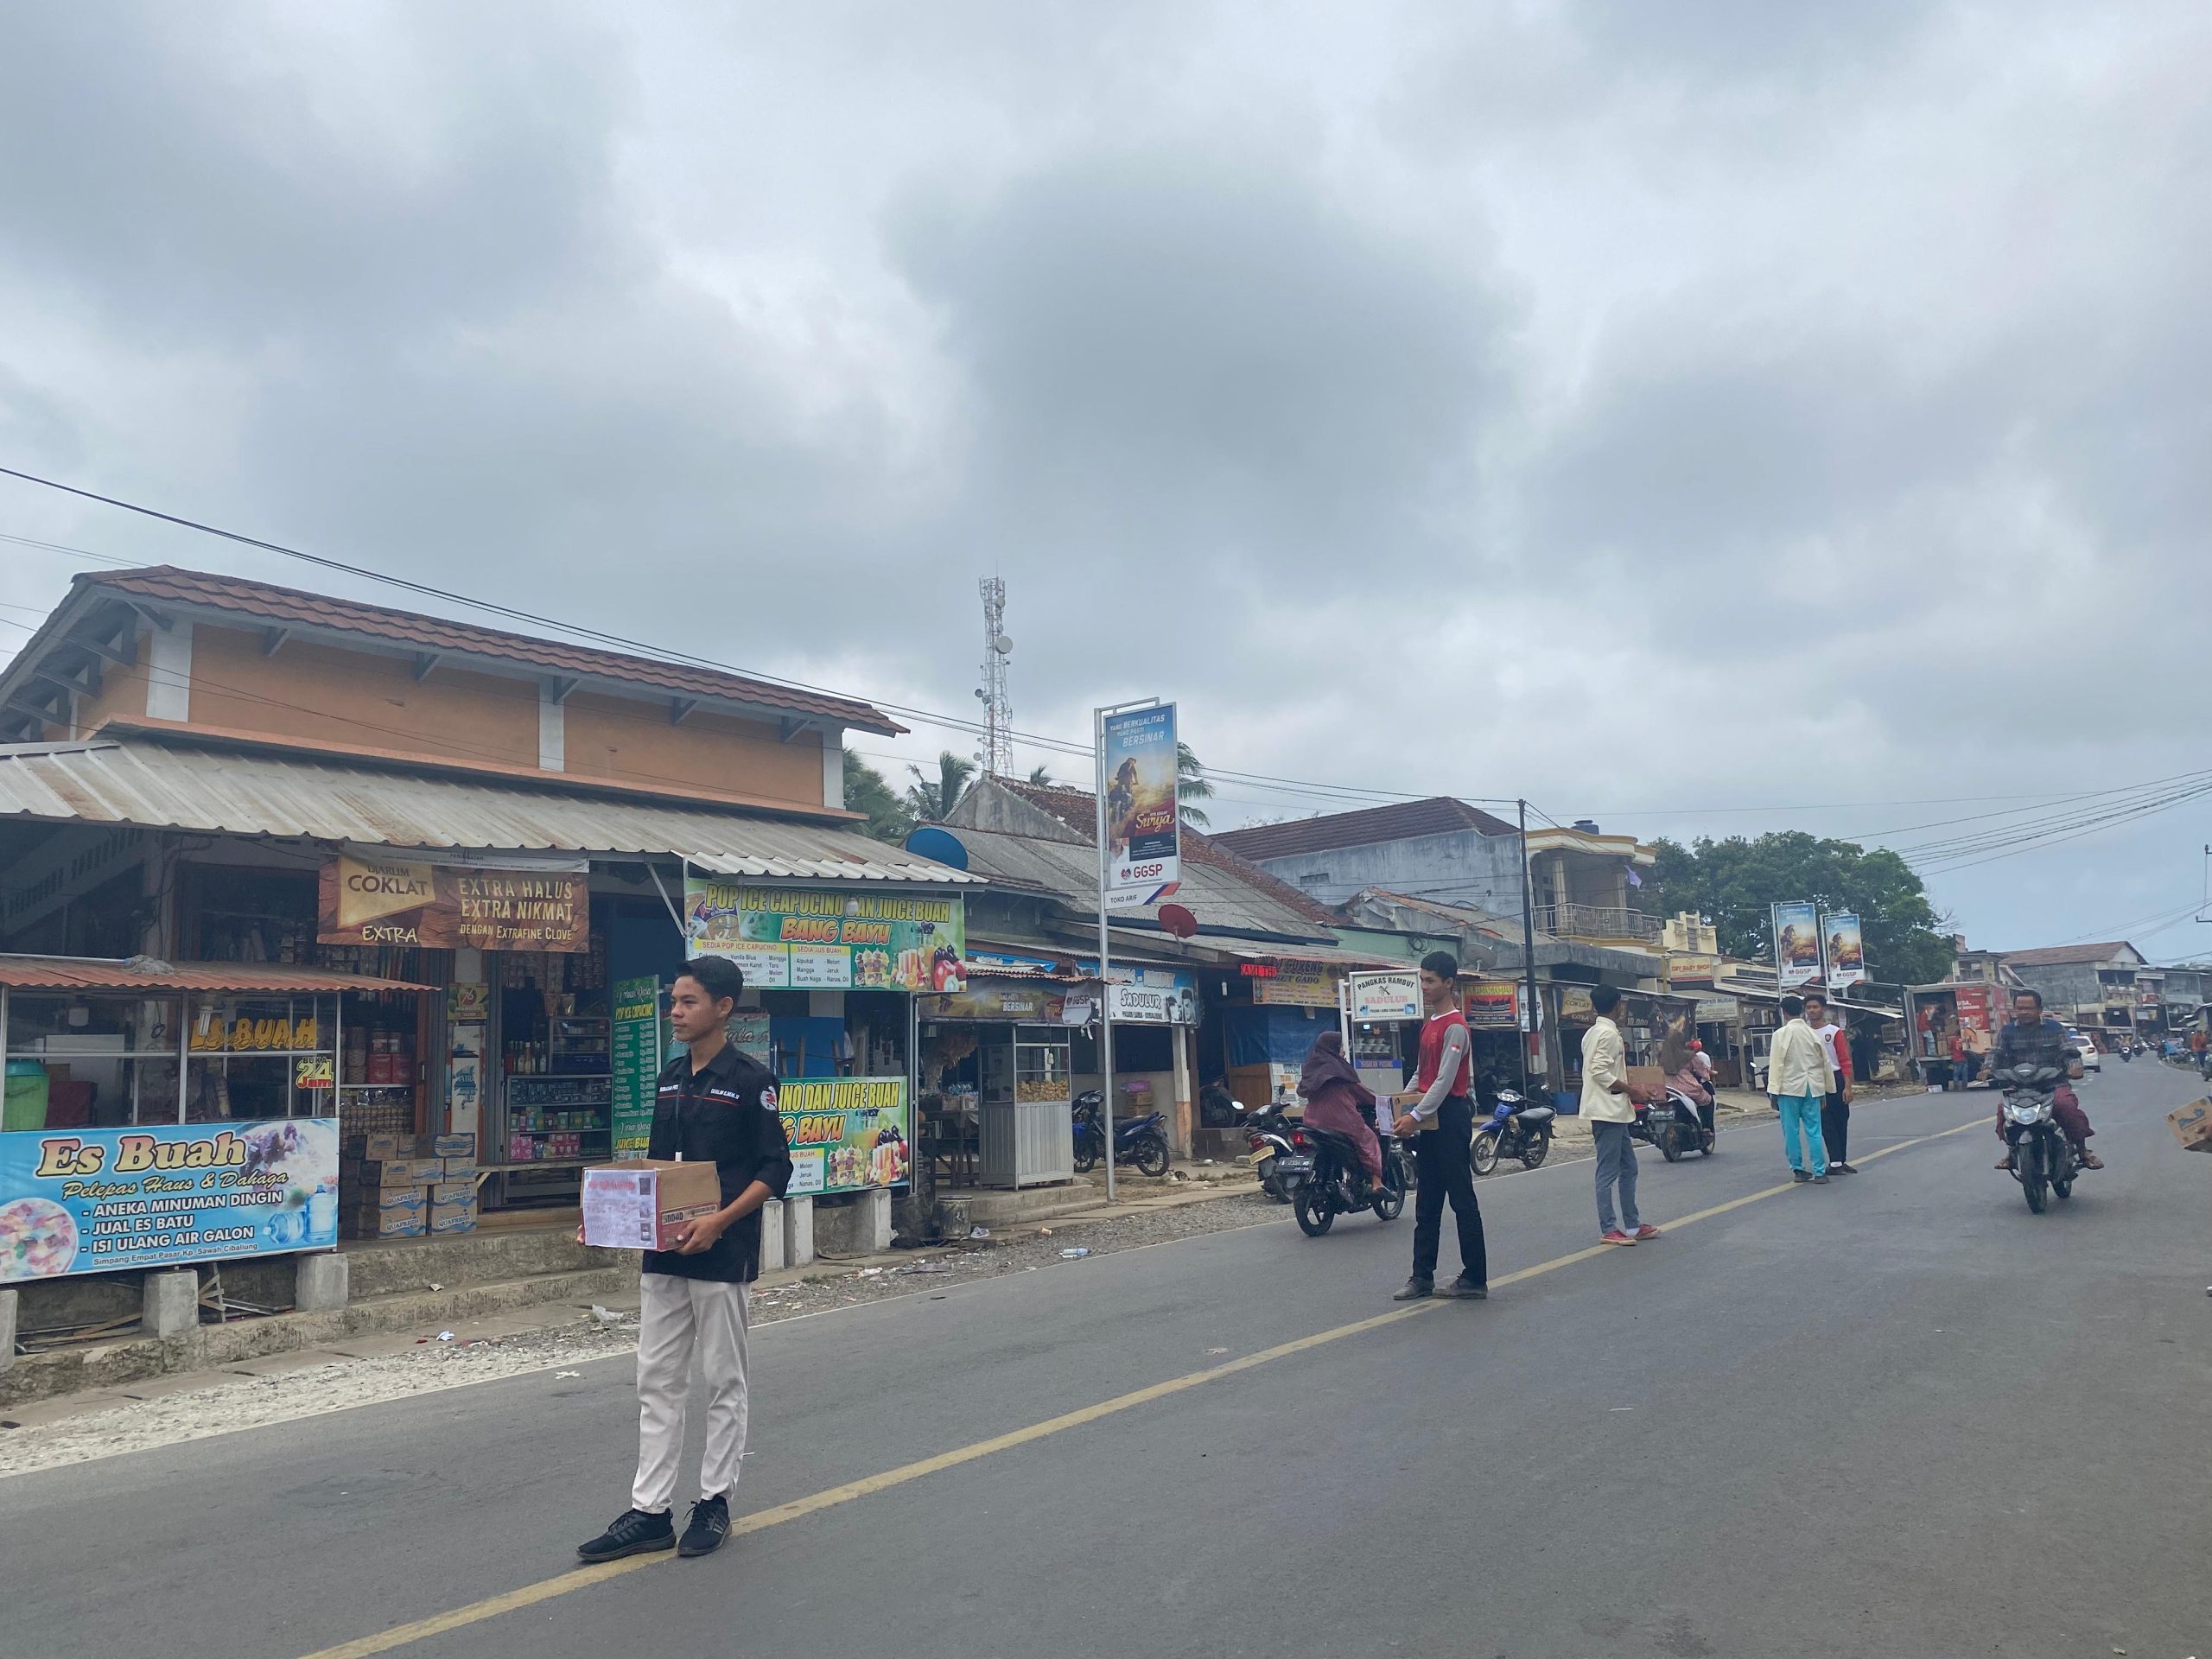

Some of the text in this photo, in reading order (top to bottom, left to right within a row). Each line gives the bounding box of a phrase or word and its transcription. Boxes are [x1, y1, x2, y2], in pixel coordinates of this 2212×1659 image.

[1123, 715, 1166, 729] BERKUALITAS
[1122, 731, 1165, 747] BERSINAR
[1135, 813, 1175, 832] Surya
[1134, 864, 1163, 878] GGSP
[347, 874, 428, 896] COKLAT
[459, 878, 573, 899] EXTRA HALUS
[461, 899, 573, 921] EXTRA NIKMAT
[706, 884, 950, 923] POP ICE CAPUCINO AN JUICE BUAH
[362, 925, 417, 943] EXTRA
[461, 924, 493, 936] DENGAN
[497, 925, 542, 940] EXTRAFINE
[780, 917, 892, 944] BANG BAYU
[1357, 977, 1415, 990] PANGKAS RAMBUT
[1002, 1001, 1033, 1012] BERSINAR
[1121, 988, 1161, 1008] SADULUR
[1364, 995, 1408, 1004] SADULUR
[1566, 1000, 1590, 1008] COKLAT
[232, 1017, 318, 1050] BUAH
[296, 1060, 334, 1085] 24
[298, 1077, 332, 1088] Jam
[804, 1084, 832, 1111] DAN
[832, 1083, 868, 1109] JUICE
[868, 1082, 899, 1109] BUAH
[797, 1115, 846, 1144] BAYU
[615, 1136, 650, 1149] JUICE BUA
[36, 1132, 246, 1176] Es Buah
[62, 1170, 288, 1200] Pelepas Haus & Dahaga
[93, 1190, 283, 1217] ANEKA MINUMAN DINGIN
[92, 1215, 194, 1236] JUAL ES BATU
[92, 1225, 255, 1253] ISI ULANG AIR GALON
[93, 1243, 257, 1268] Simpang Empat Pasar Kp. Sawah Cibaliung
